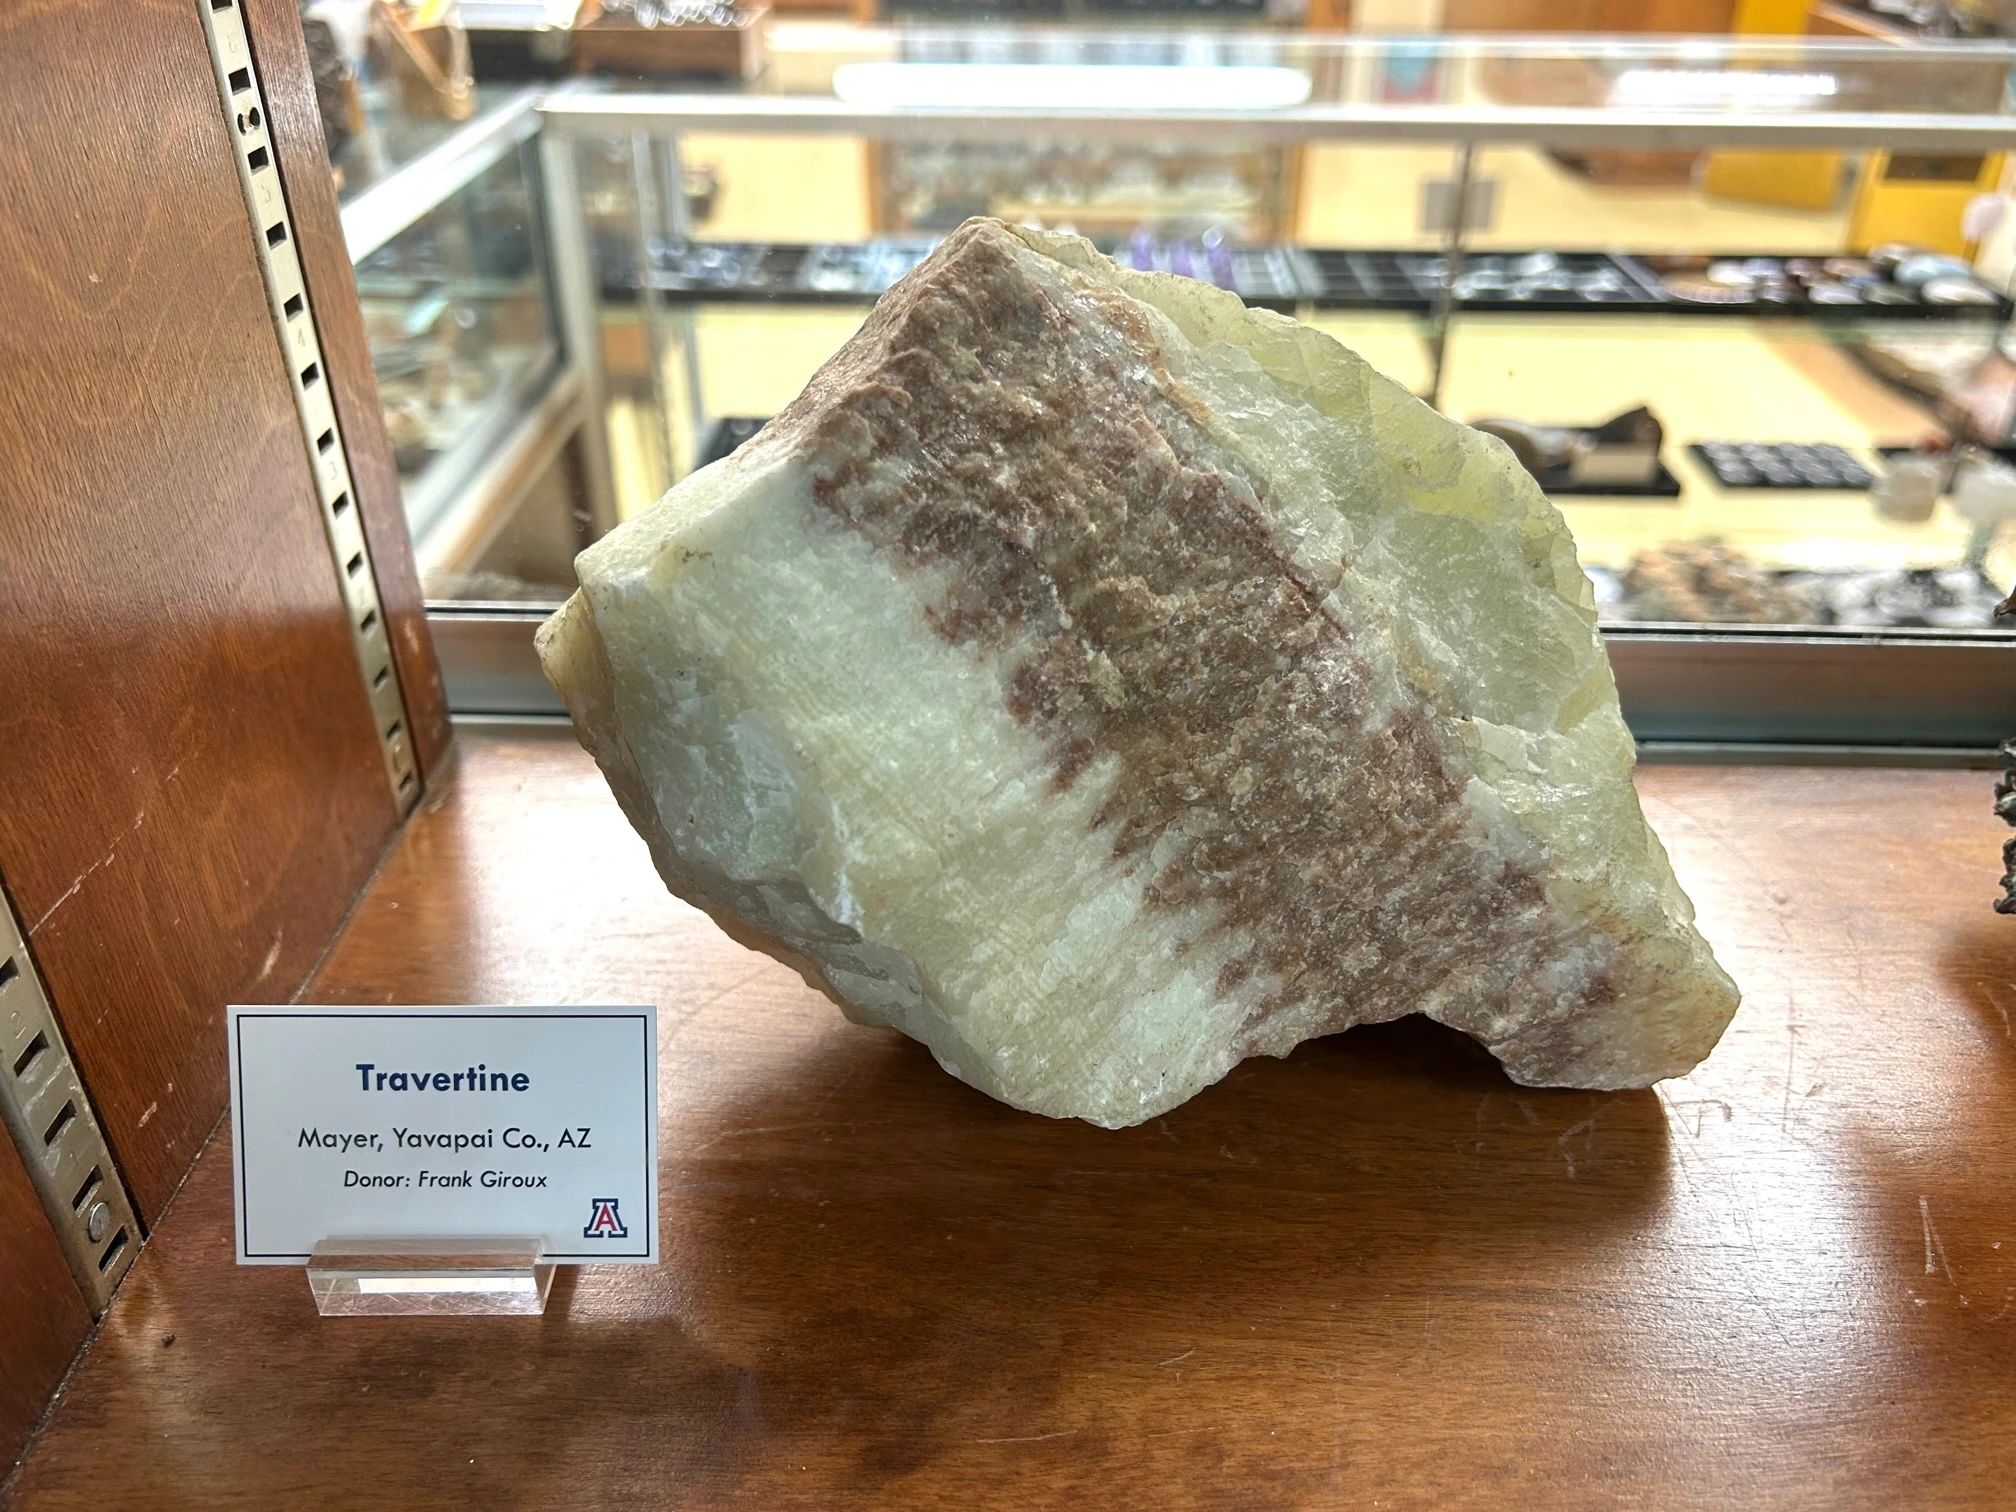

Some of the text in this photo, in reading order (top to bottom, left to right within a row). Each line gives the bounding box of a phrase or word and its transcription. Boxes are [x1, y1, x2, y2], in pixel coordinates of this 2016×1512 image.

[8, 1010, 27, 1039] 2
[355, 1063, 530, 1092] Travertine
[297, 1127, 592, 1153] Mayer, Yavapai Co., AZ
[343, 1169, 548, 1188] Donor: Frank Giroux
[583, 1197, 629, 1239] A
